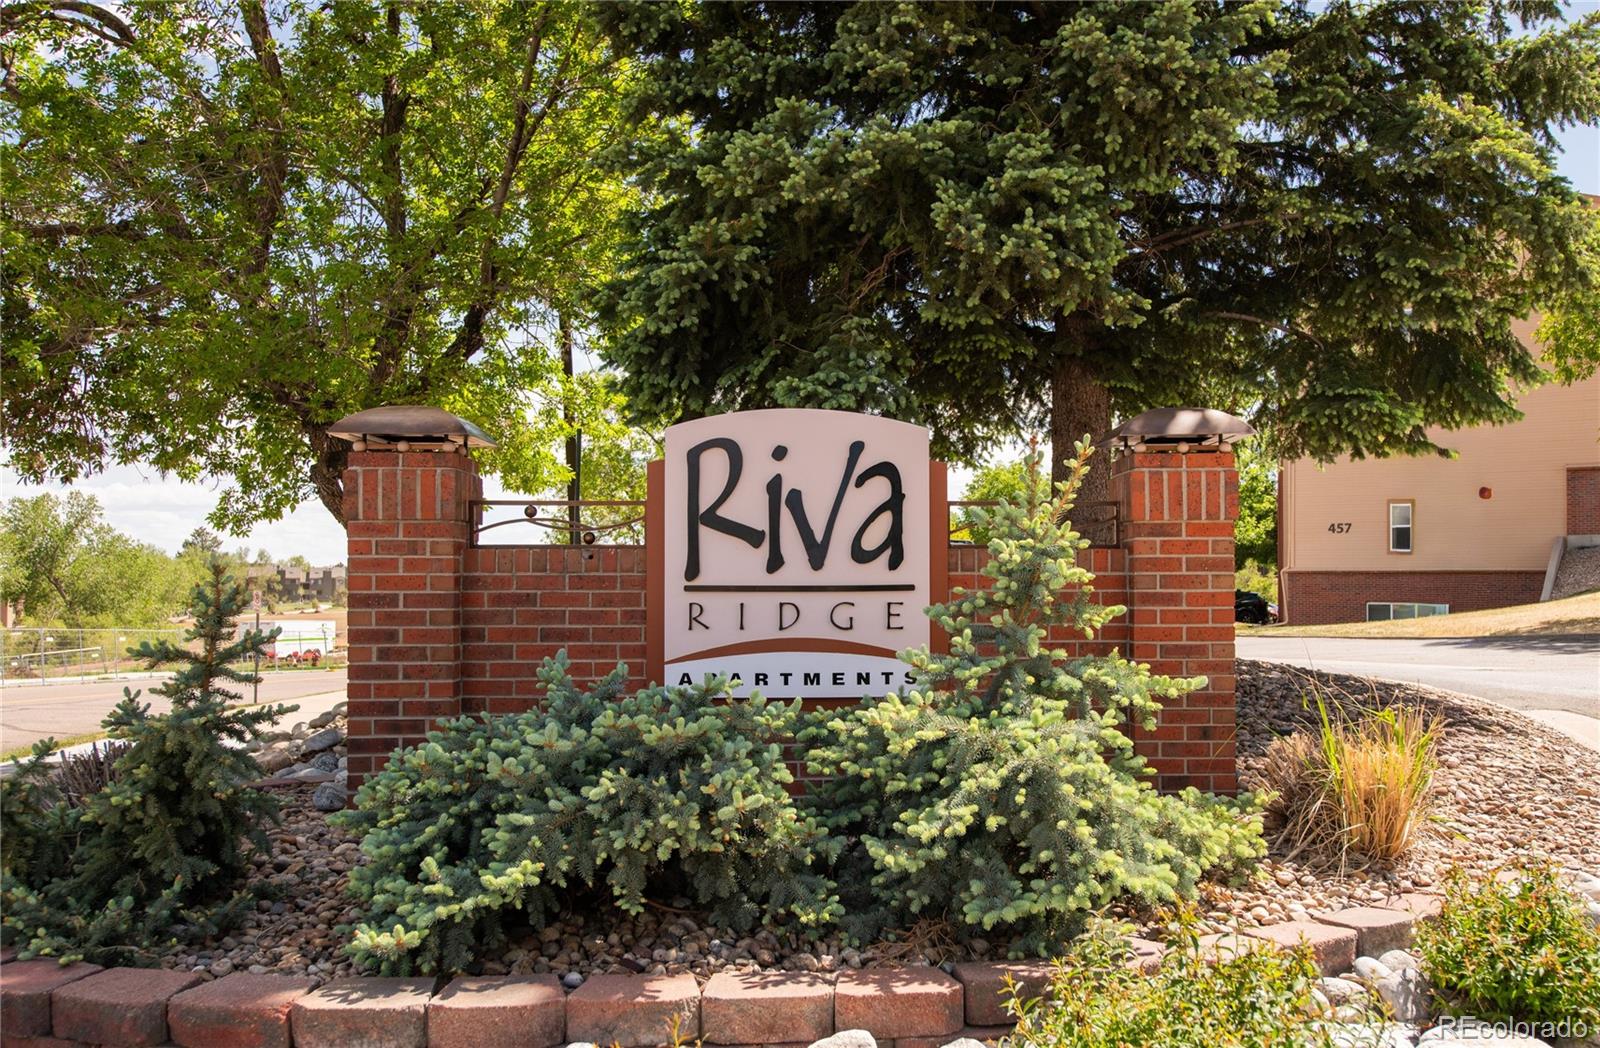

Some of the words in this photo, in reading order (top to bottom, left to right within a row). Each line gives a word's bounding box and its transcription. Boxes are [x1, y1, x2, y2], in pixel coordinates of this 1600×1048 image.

[684, 437, 906, 582] Riva
[1327, 522, 1352, 534] 457
[688, 601, 904, 631] RIDGE
